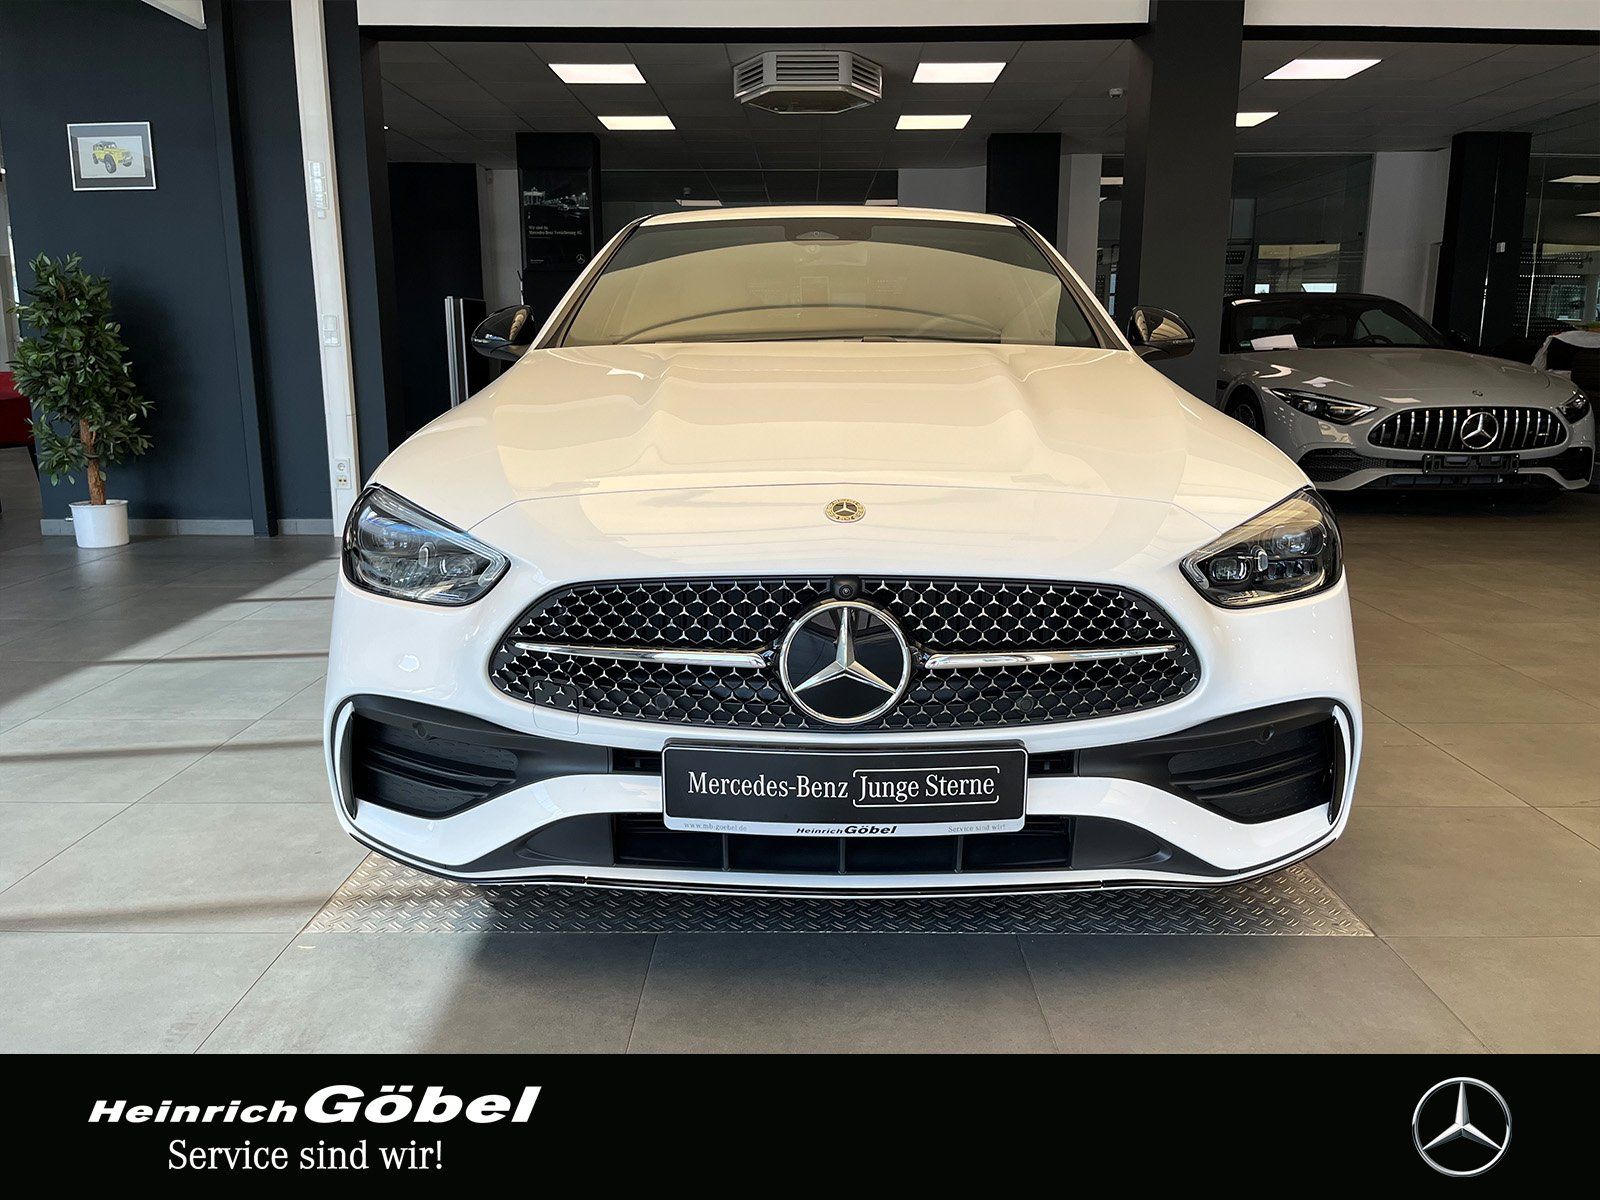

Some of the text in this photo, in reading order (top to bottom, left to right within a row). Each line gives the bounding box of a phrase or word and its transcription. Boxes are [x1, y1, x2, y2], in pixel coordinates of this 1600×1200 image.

[687, 771, 995, 803] Mercedes-Benz Junge Sterne
[844, 825, 898, 835] Göbel
[948, 825, 974, 833] Service
[975, 824, 990, 832] sind
